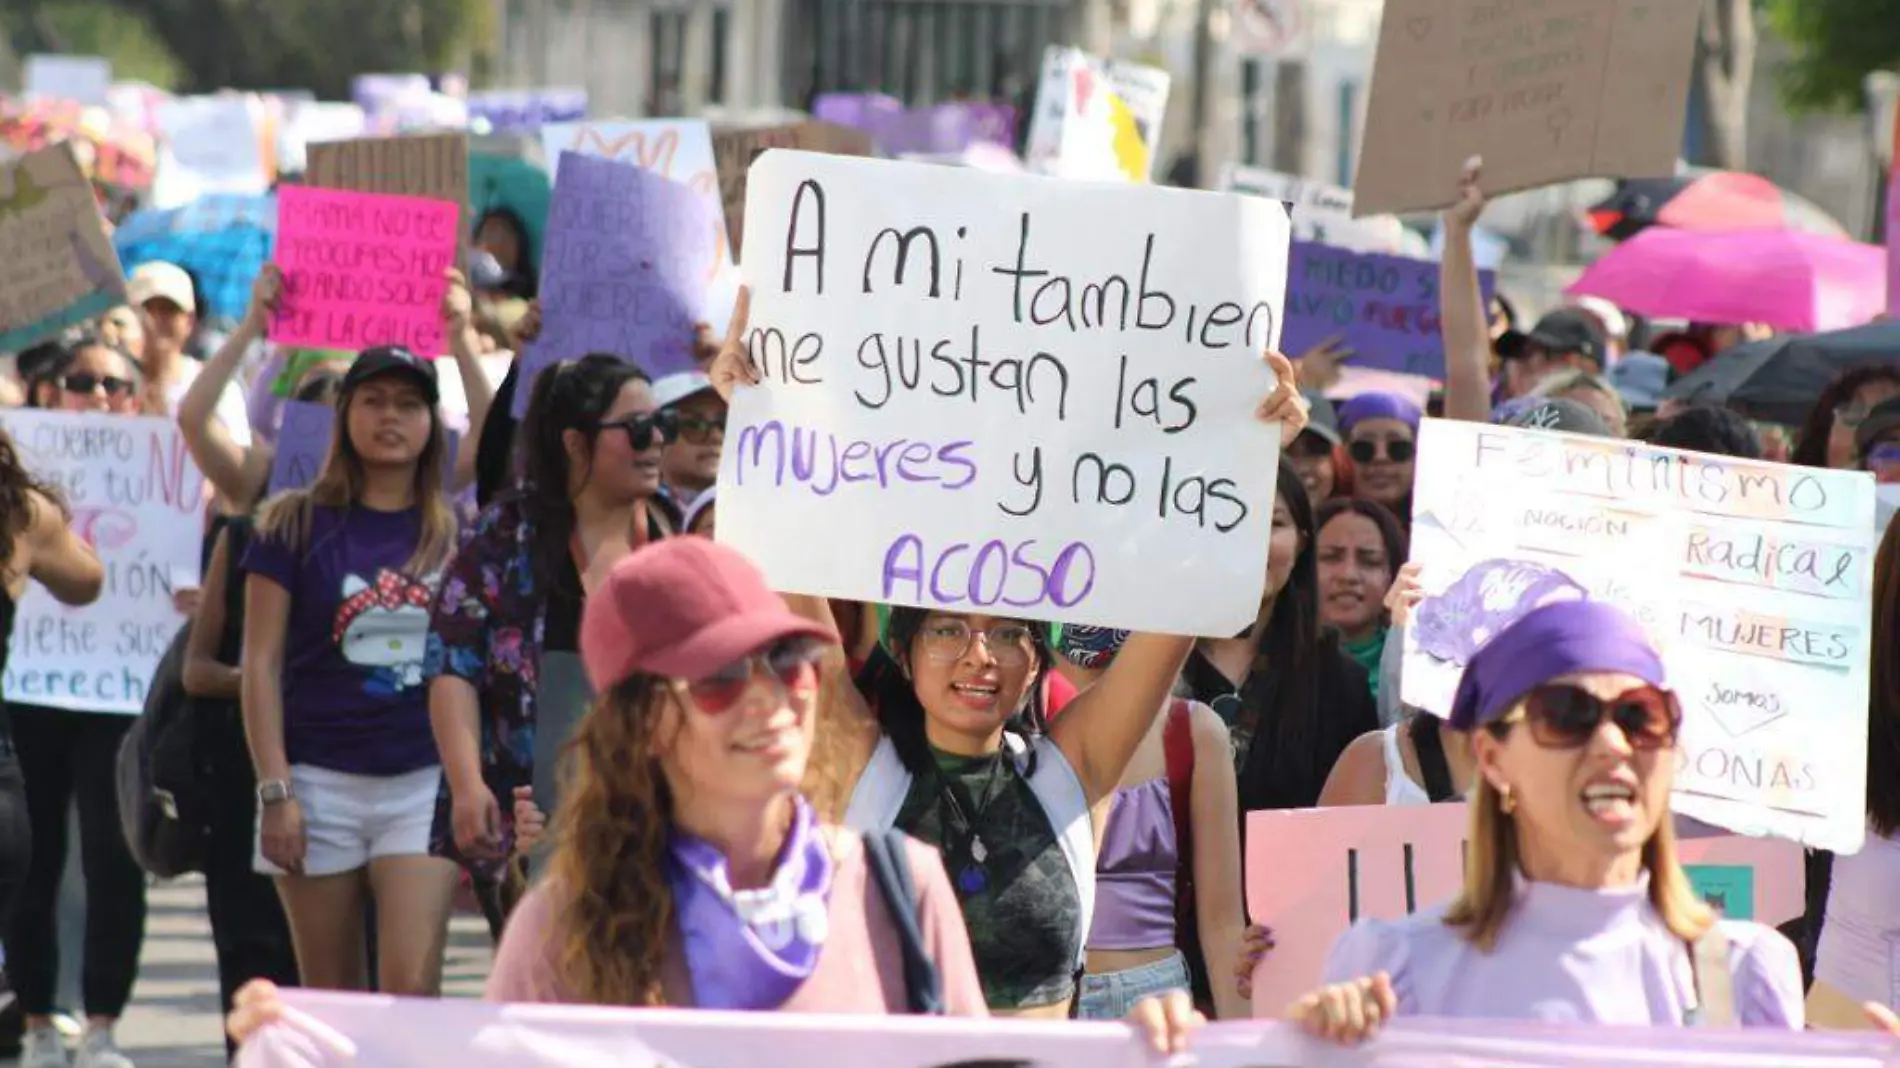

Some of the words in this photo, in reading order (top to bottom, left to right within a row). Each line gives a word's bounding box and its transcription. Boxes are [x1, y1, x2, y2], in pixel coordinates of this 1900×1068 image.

[783, 178, 825, 295] A
[862, 225, 967, 301] mi
[992, 211, 1274, 350] tambien
[1306, 256, 1402, 294] MIEDO
[747, 326, 824, 386] me
[853, 324, 1069, 421] gustan
[1114, 354, 1198, 434] las
[997, 446, 1043, 516] y
[1072, 452, 1135, 506] no
[1157, 455, 1249, 532] las
[881, 533, 1097, 609] ACOSO
[1679, 611, 1850, 661] MUJERES
